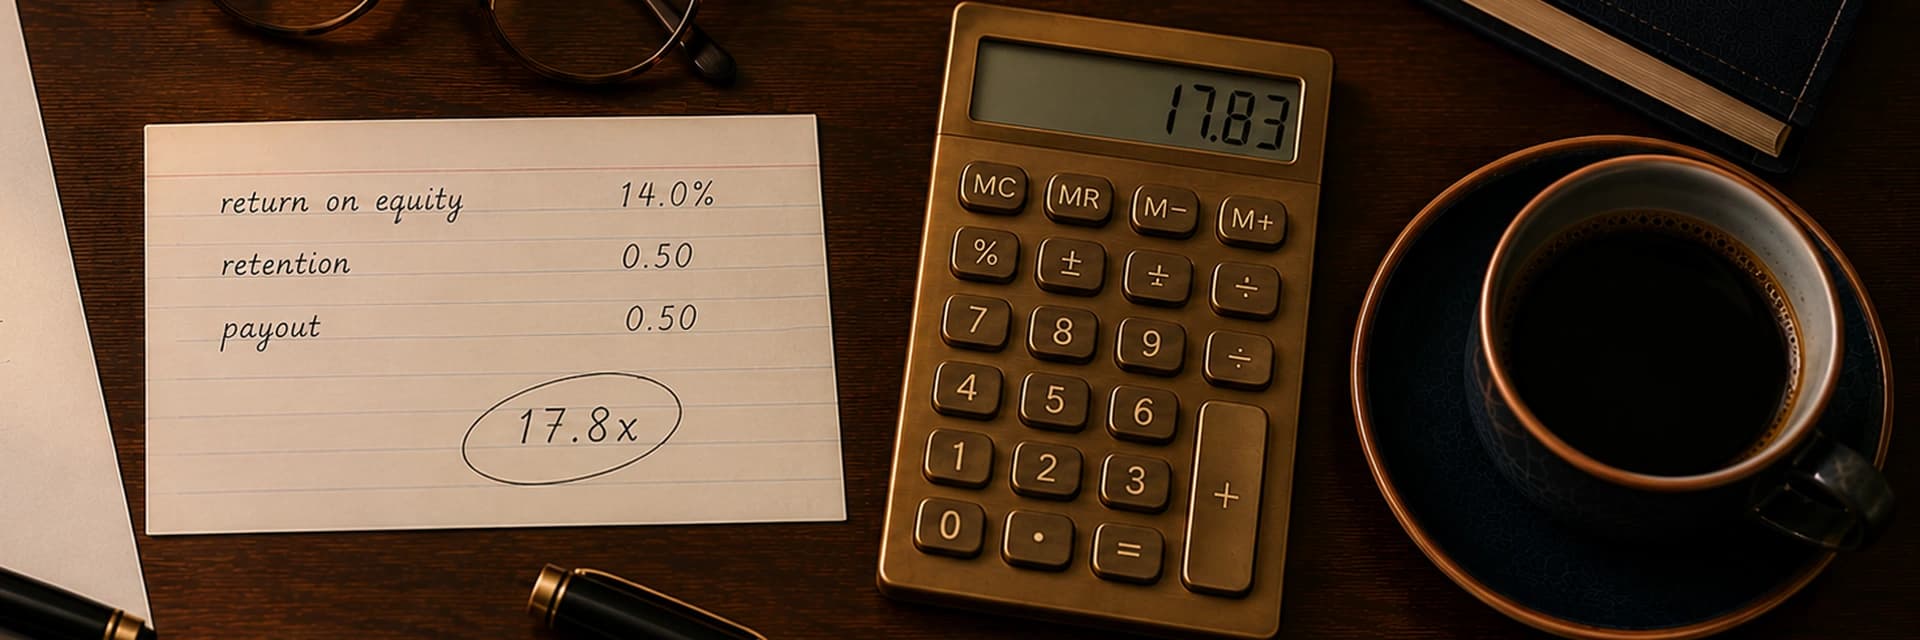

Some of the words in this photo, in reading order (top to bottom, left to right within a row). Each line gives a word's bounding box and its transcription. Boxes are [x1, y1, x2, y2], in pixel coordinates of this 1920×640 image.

[1166, 84, 1290, 151] 17.83
[973, 173, 1017, 199] MC
[1058, 184, 1100, 211] MR
[220, 191, 309, 213] return
[326, 194, 359, 212] on
[375, 187, 464, 224] equity
[620, 180, 714, 208] 14.0%
[1231, 207, 1274, 231] M+
[221, 251, 351, 276] retention
[622, 242, 694, 269] 0.50
[973, 238, 999, 266] %
[220, 314, 321, 352] payout
[625, 304, 697, 332] 0.50
[968, 305, 988, 334] 7
[1052, 317, 1073, 346] 8
[1142, 329, 1162, 358] 9
[956, 373, 977, 401] 4
[1045, 385, 1065, 414] 5
[520, 406, 639, 444] 17.8x
[1134, 397, 1154, 427] 6
[952, 441, 965, 471] 1
[1036, 453, 1057, 483] 2
[1125, 466, 1146, 495] 3
[1213, 481, 1240, 509] +
[939, 510, 961, 540] 0
[1117, 542, 1142, 558] =
